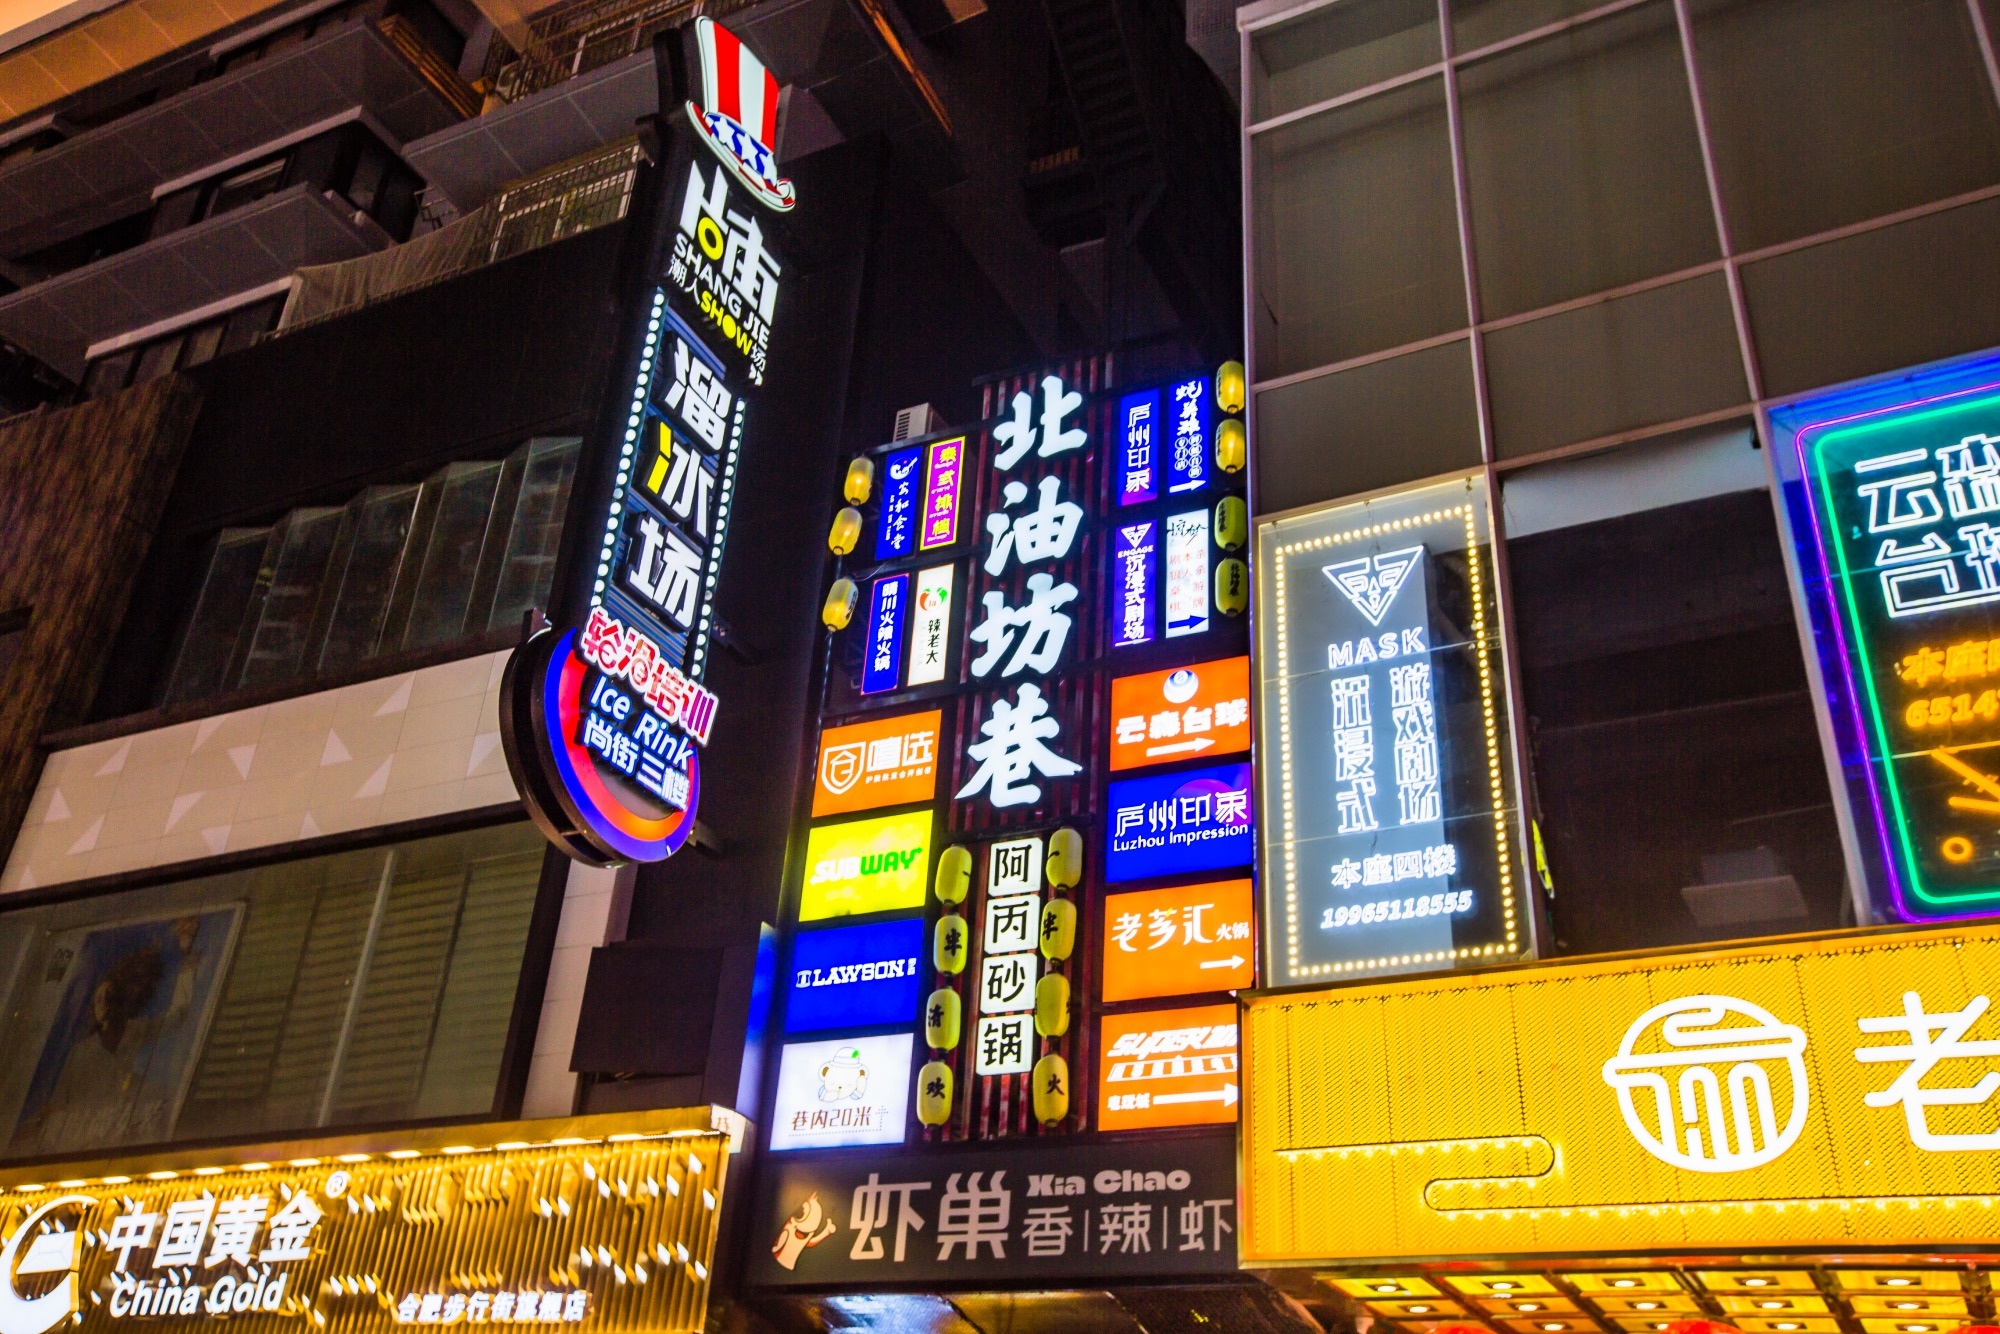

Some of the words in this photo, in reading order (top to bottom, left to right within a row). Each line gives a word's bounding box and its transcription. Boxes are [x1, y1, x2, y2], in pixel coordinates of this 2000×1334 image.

[674, 232, 742, 319] SHANG
[743, 311, 770, 350] JIE
[1126, 402, 1151, 493] 庐州印象
[630, 337, 732, 628] 溜冰场
[954, 375, 1087, 808] 北油坊巷
[926, 618, 941, 665] 辣老大
[1328, 626, 1425, 670] MASK
[582, 607, 717, 744] 轮滑培训
[590, 675, 631, 721] Ice
[634, 712, 694, 771] Rink
[1114, 787, 1248, 838] 庐州印象
[1114, 832, 1164, 852] Luzhou
[1170, 823, 1248, 846] Impression
[810, 847, 923, 886] SUBWAY
[1331, 843, 1457, 889] 本座四楼
[1320, 889, 1473, 930] 19965118555
[812, 959, 905, 987] LAWSON
[984, 843, 1033, 1067] 阿丙砂锅
[1854, 990, 2000, 1152] 老
[1026, 1174, 1085, 1198] Xia
[1093, 1169, 1191, 1195] Chao
[106, 1189, 324, 1273] 中国黄金
[849, 1170, 1011, 1262] 虾巢
[109, 1274, 200, 1318] China
[208, 1271, 287, 1315] Gold
[398, 1289, 587, 1324] 合肥步行街旗舰店
